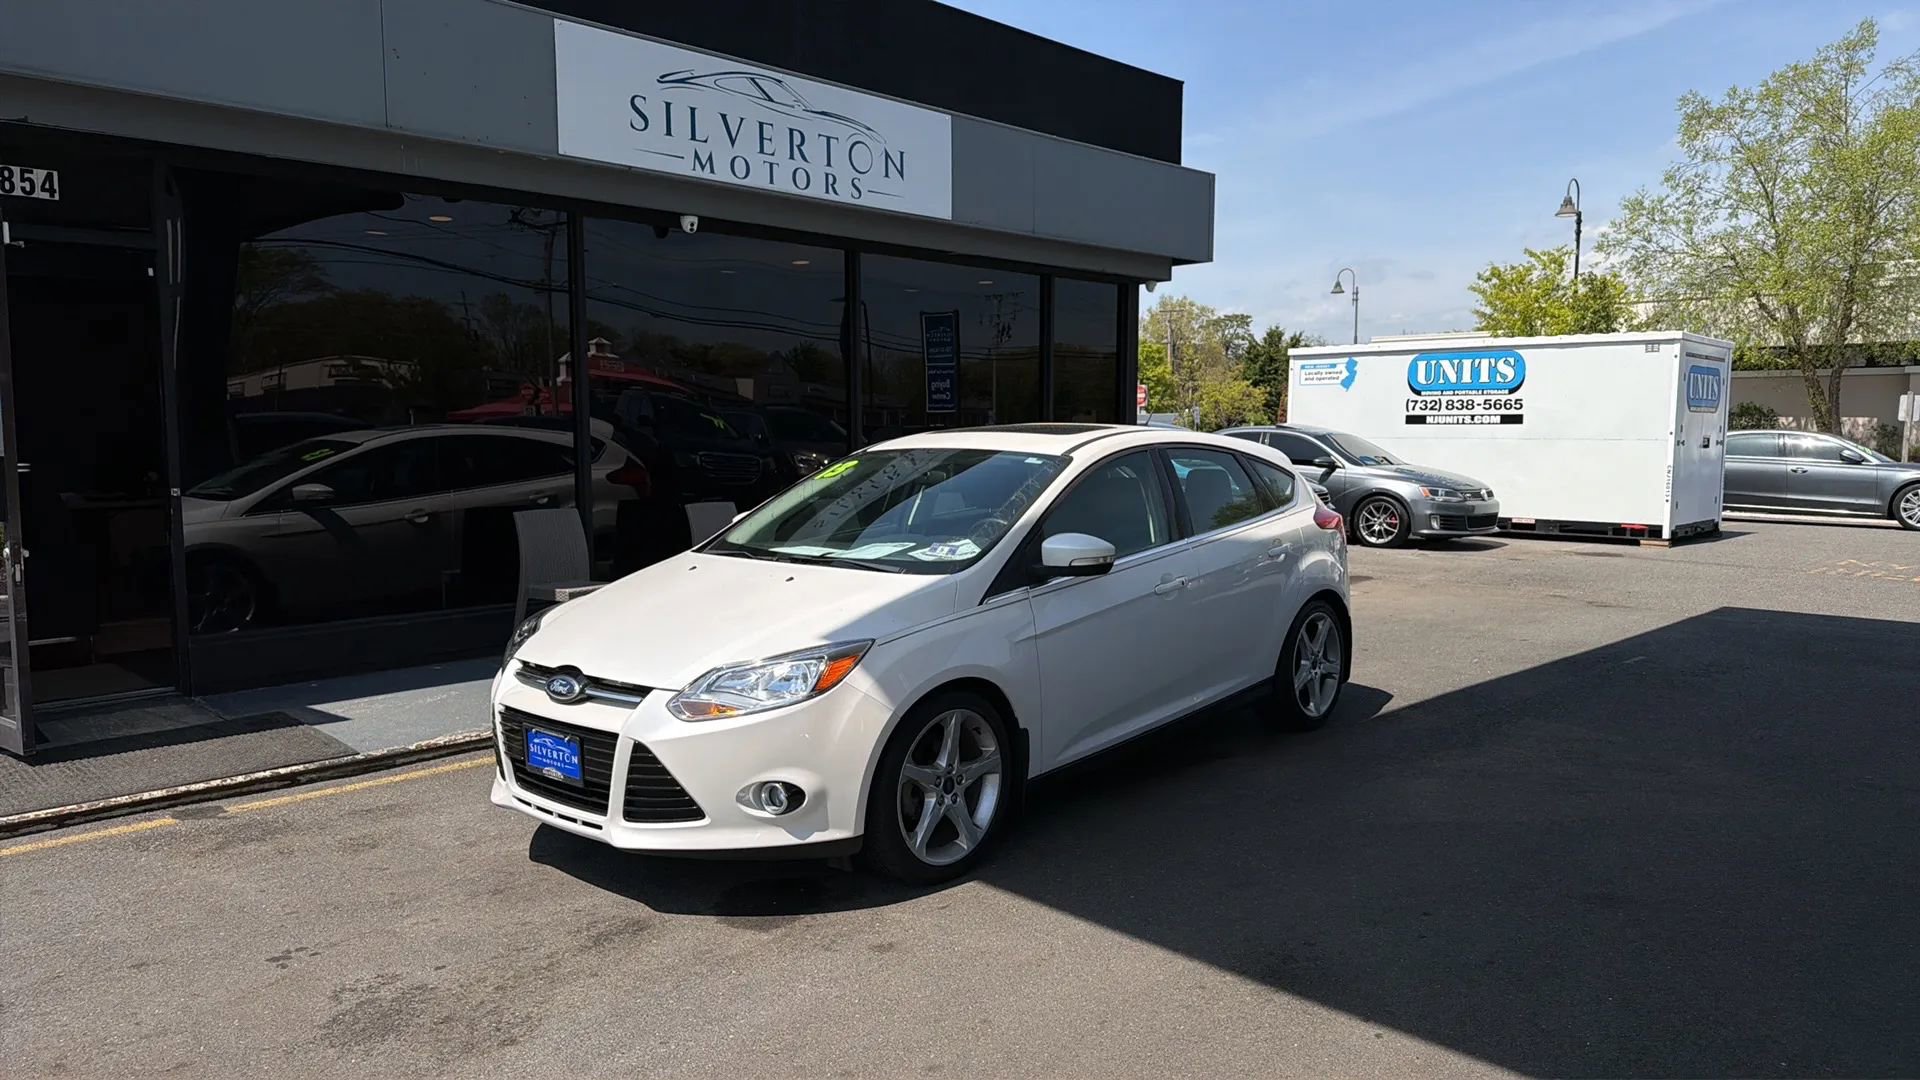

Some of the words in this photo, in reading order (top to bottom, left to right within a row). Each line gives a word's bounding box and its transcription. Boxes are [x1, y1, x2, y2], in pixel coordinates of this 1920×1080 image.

[629, 94, 905, 181] SILVERTON
[0, 166, 57, 199] 854
[692, 148, 863, 199] MOTORS
[1416, 357, 1516, 385] UNITS
[1690, 373, 1719, 400] UNITS
[1406, 398, 1442, 412] (732)
[1445, 399, 1524, 411] 838-5665
[1426, 415, 1501, 424] NJUNITS.COM
[549, 679, 571, 695] Ford
[529, 743, 578, 765] SILVERTON
